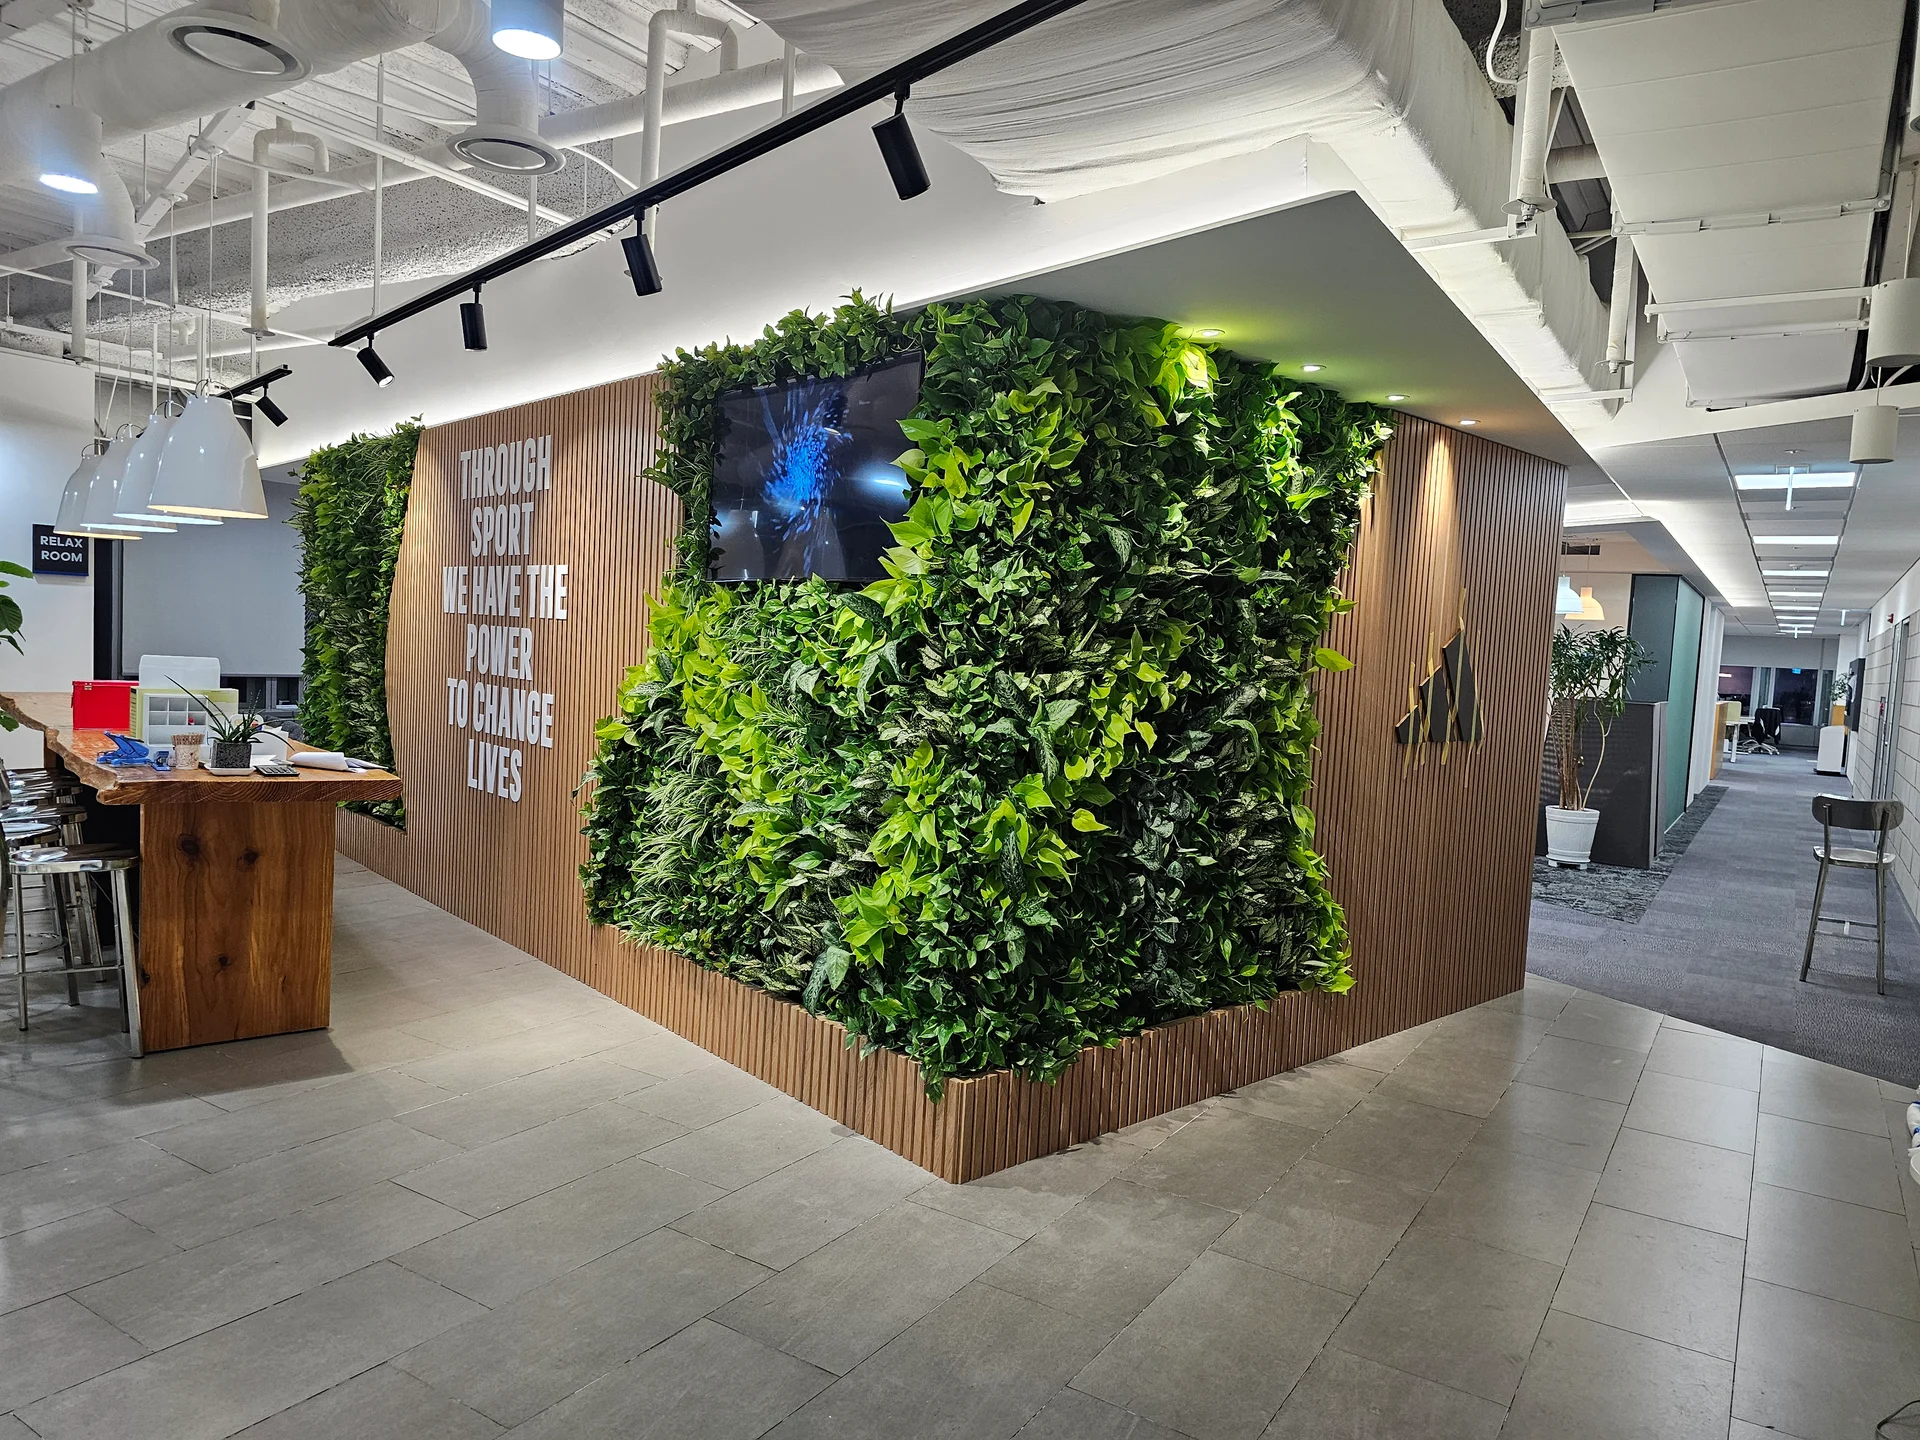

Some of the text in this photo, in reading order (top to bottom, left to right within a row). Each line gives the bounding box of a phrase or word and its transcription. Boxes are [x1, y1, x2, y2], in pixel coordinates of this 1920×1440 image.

[461, 435, 551, 500] THROUGH
[40, 535, 83, 548] RELAX
[41, 550, 83, 562] ROOM
[471, 502, 534, 557] SPORT
[443, 564, 568, 620] WE HAVE THE
[466, 623, 533, 681] POWER
[447, 677, 554, 749] TO CHANGE
[467, 738, 522, 803] LIVES
